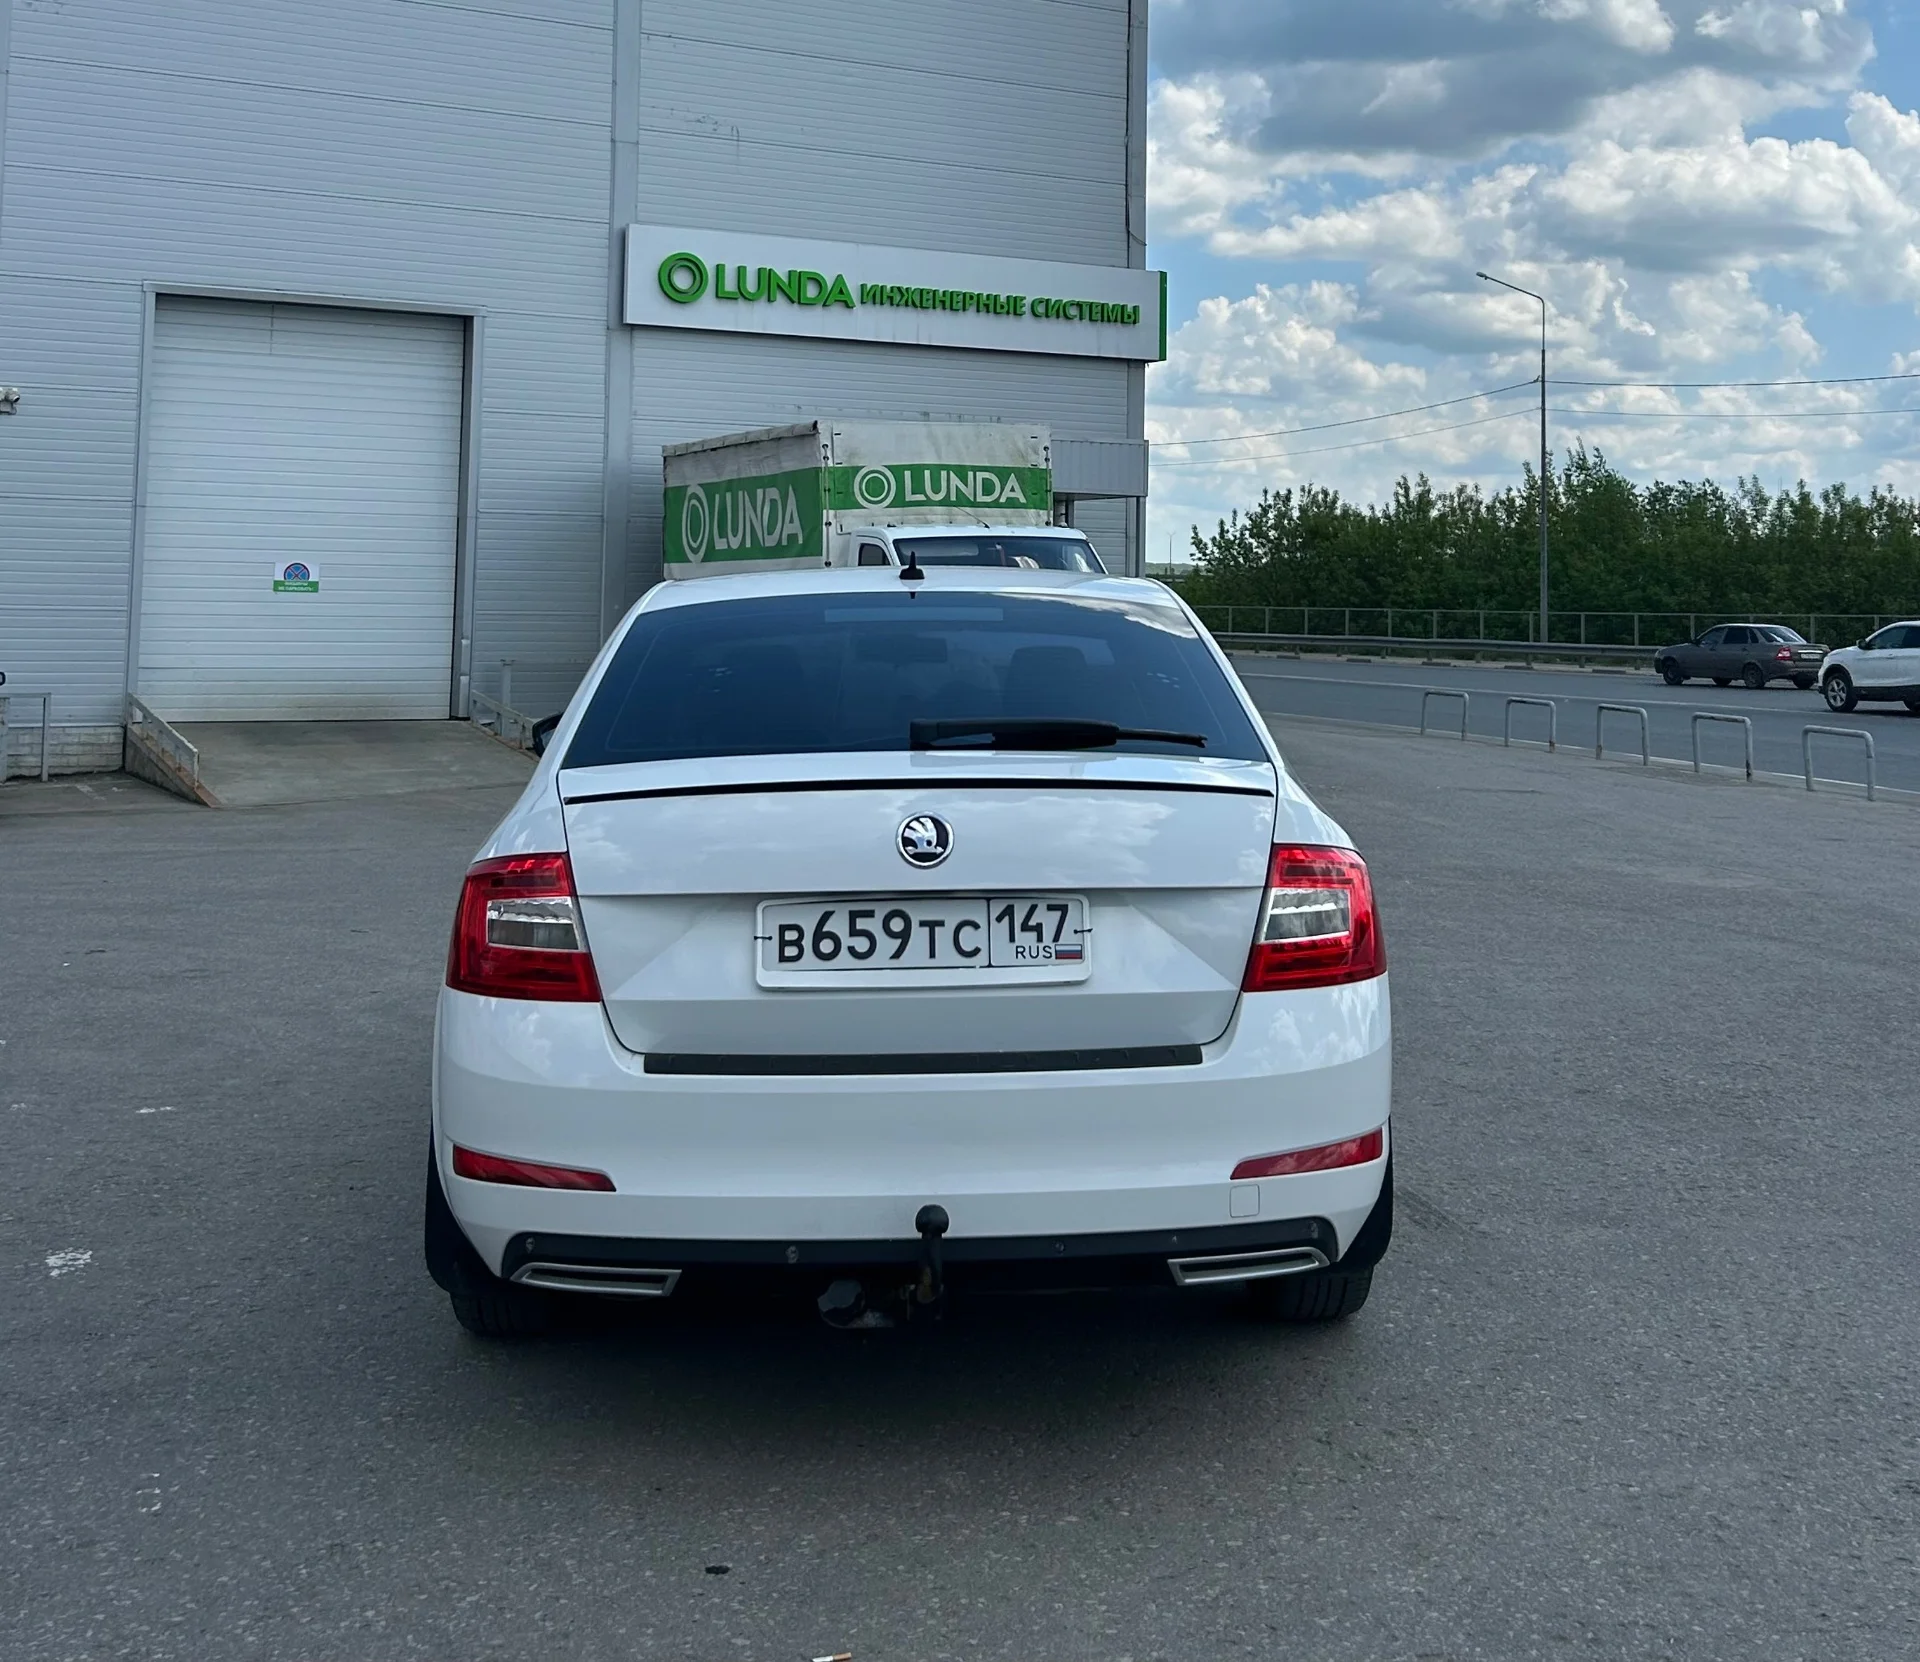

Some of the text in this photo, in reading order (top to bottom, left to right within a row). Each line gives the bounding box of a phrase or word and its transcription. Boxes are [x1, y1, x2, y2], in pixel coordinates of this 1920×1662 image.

[715, 263, 1140, 325] LUNDA ИНЖЕНЕРНЫЕ СИСТЕМЫ
[904, 469, 1027, 503] LUNDA
[713, 484, 803, 550] LUNDA
[995, 903, 1069, 944] 147
[1015, 944, 1052, 960] RUS
